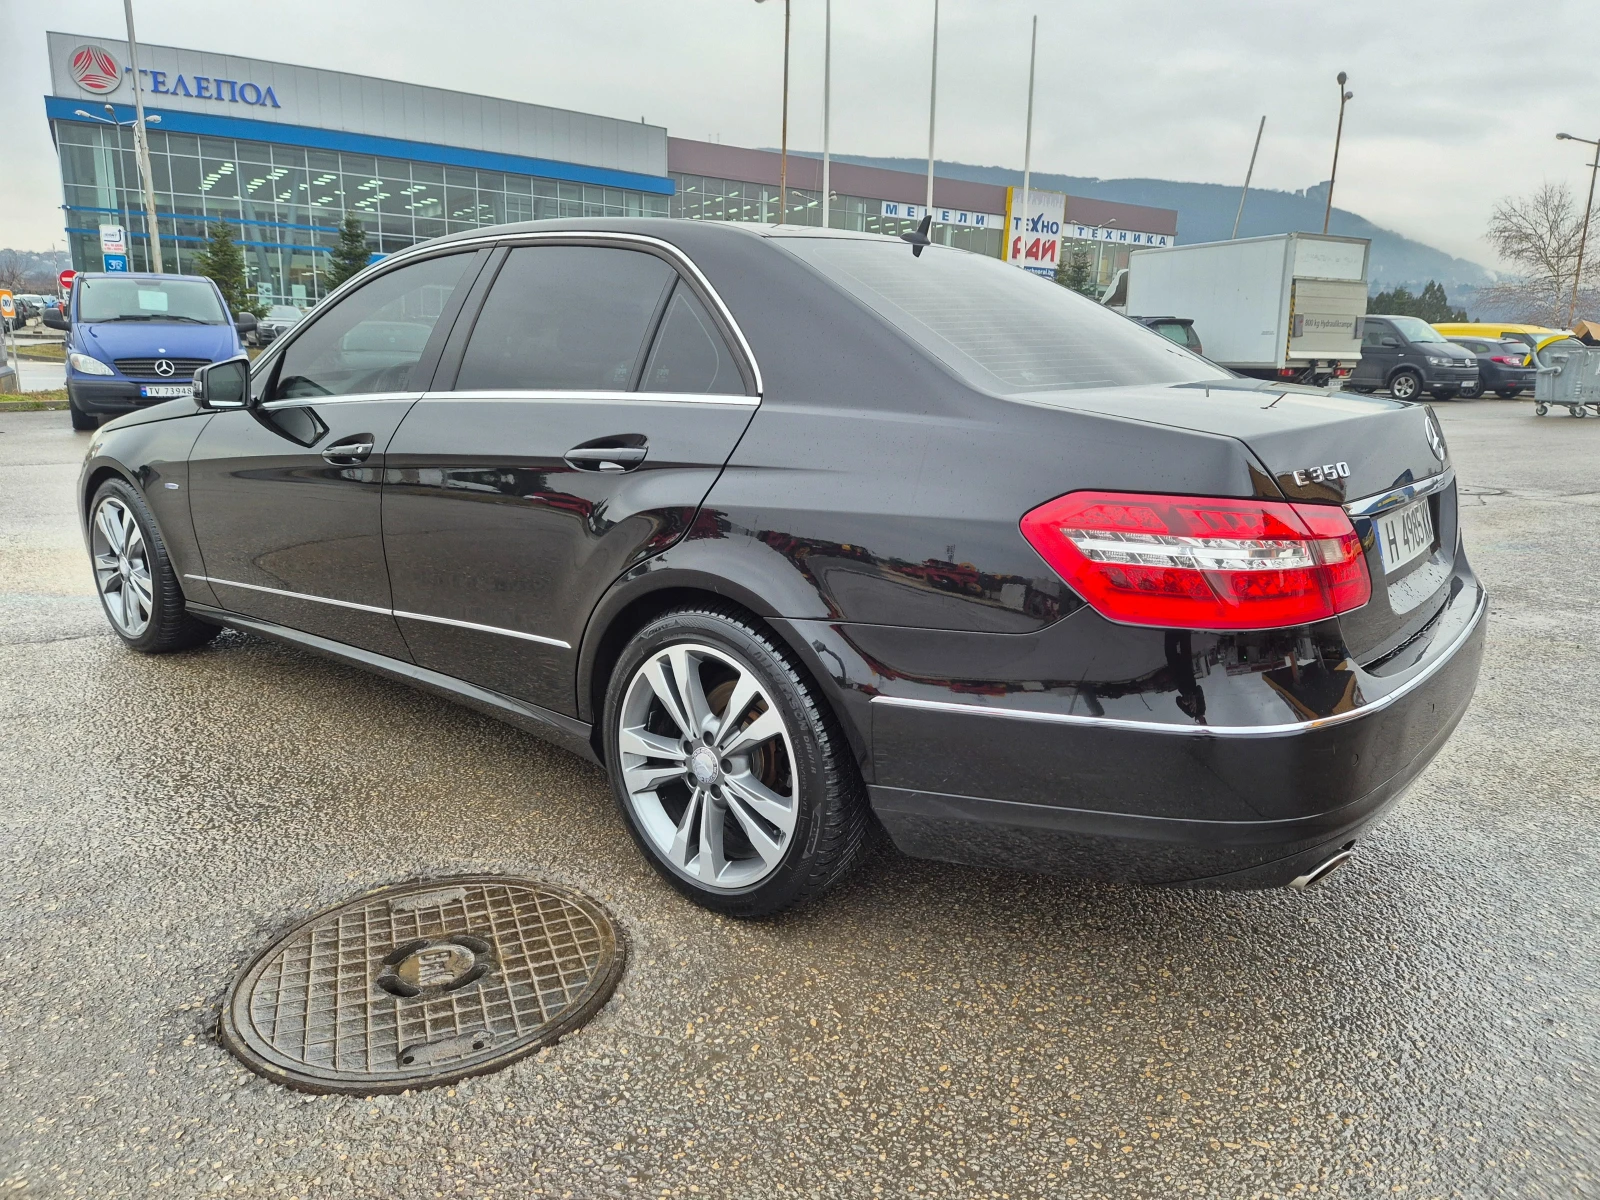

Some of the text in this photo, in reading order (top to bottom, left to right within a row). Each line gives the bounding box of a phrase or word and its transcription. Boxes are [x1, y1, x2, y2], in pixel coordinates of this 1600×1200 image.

[125, 66, 281, 108] ТЕЛЕПОЛ
[885, 203, 985, 226] МЕЕЛИ
[1077, 227, 1167, 246] ТЕХНИКА
[1304, 319, 1314, 327] 800
[149, 387, 160, 395] TV
